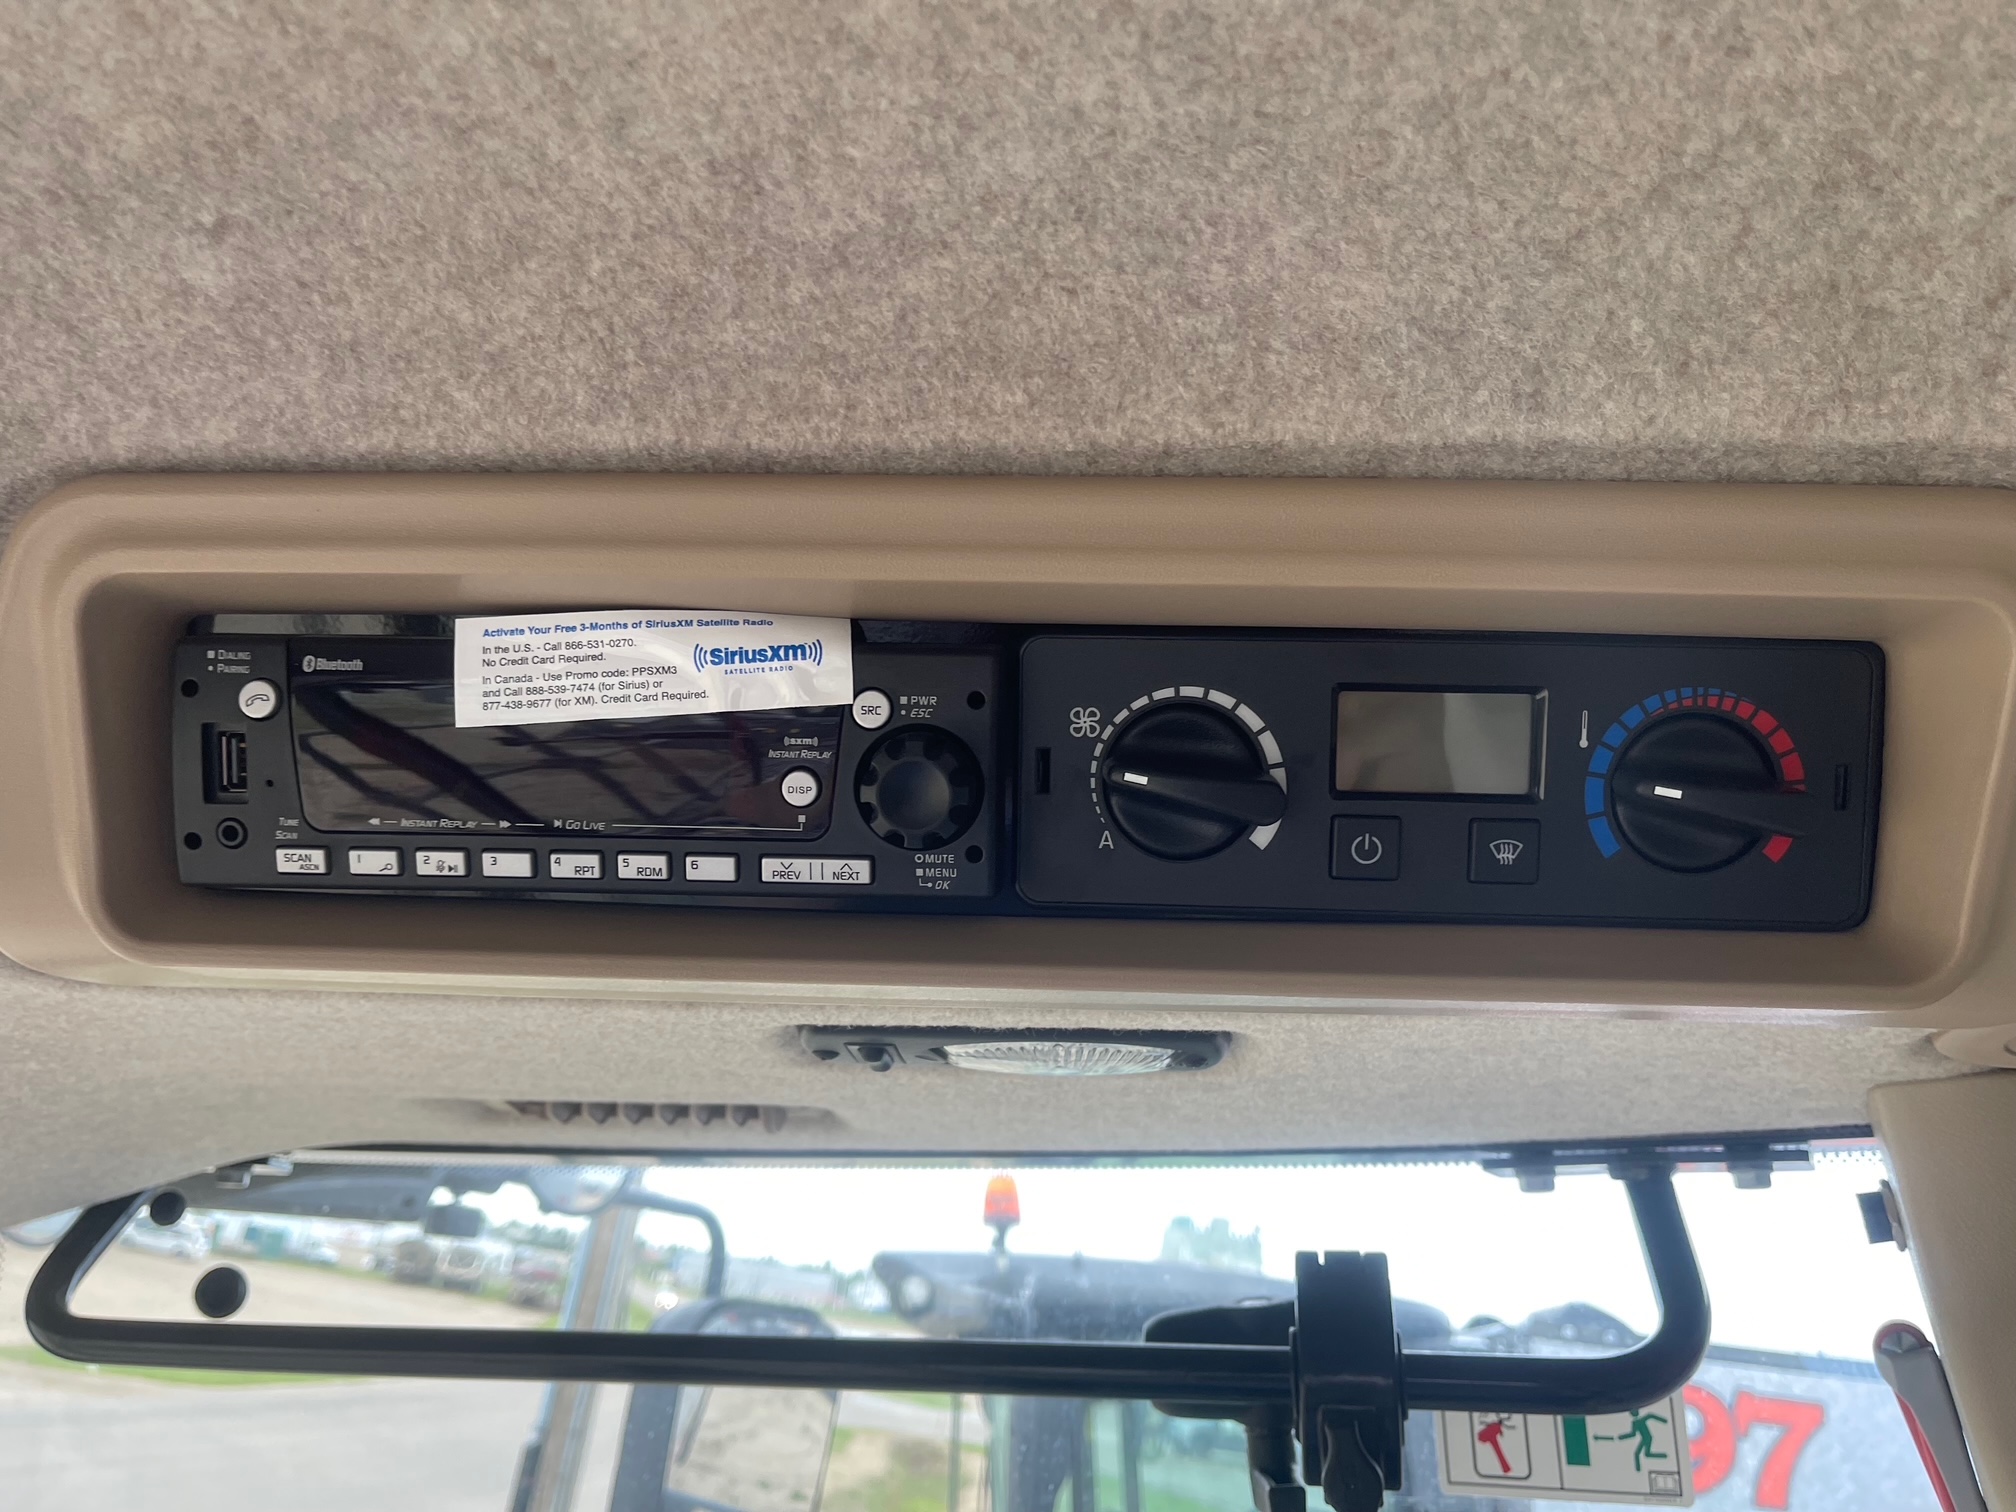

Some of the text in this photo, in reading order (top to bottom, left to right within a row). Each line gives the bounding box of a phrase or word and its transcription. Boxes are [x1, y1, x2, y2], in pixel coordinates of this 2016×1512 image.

[482, 618, 774, 638] Activate Your Free 3-Months of SiriusXM Satellite Radio
[482, 646, 492, 654] In
[494, 645, 510, 654] the
[512, 644, 534, 654] U.S.
[543, 642, 562, 652] Call
[564, 638, 636, 650] 866-531-0270.
[316, 658, 364, 671] Bluetooth
[482, 653, 606, 668] No Credit Card Required.
[724, 665, 794, 675] SATELLITE RADIO
[482, 676, 492, 685] In
[494, 674, 534, 684] Canada
[542, 672, 562, 682] Use
[565, 670, 598, 680] Promo
[601, 668, 629, 678] code:
[632, 666, 677, 677] PPSXM3
[482, 679, 663, 698] and Call 888-539-7474 (for Sirius) or
[482, 690, 709, 711] 877-438-9677 (for XM). Credit Card Required.
[910, 696, 937, 706] PWR
[860, 706, 882, 716] SRC
[910, 709, 933, 718] ESC
[787, 786, 812, 794] DISP
[1098, 830, 1114, 850] A
[283, 853, 312, 862] SCAN
[423, 855, 431, 864] 2
[490, 856, 498, 865] 3
[553, 857, 561, 866] 4
[925, 854, 955, 864] MUTE
[622, 858, 630, 868] 5
[691, 860, 698, 869] 6
[574, 866, 596, 876] RPT
[636, 867, 663, 877] RDM
[772, 871, 801, 880] PREV
[832, 872, 860, 880] NEXT
[925, 868, 957, 877] MENU
[935, 881, 950, 890] OK
